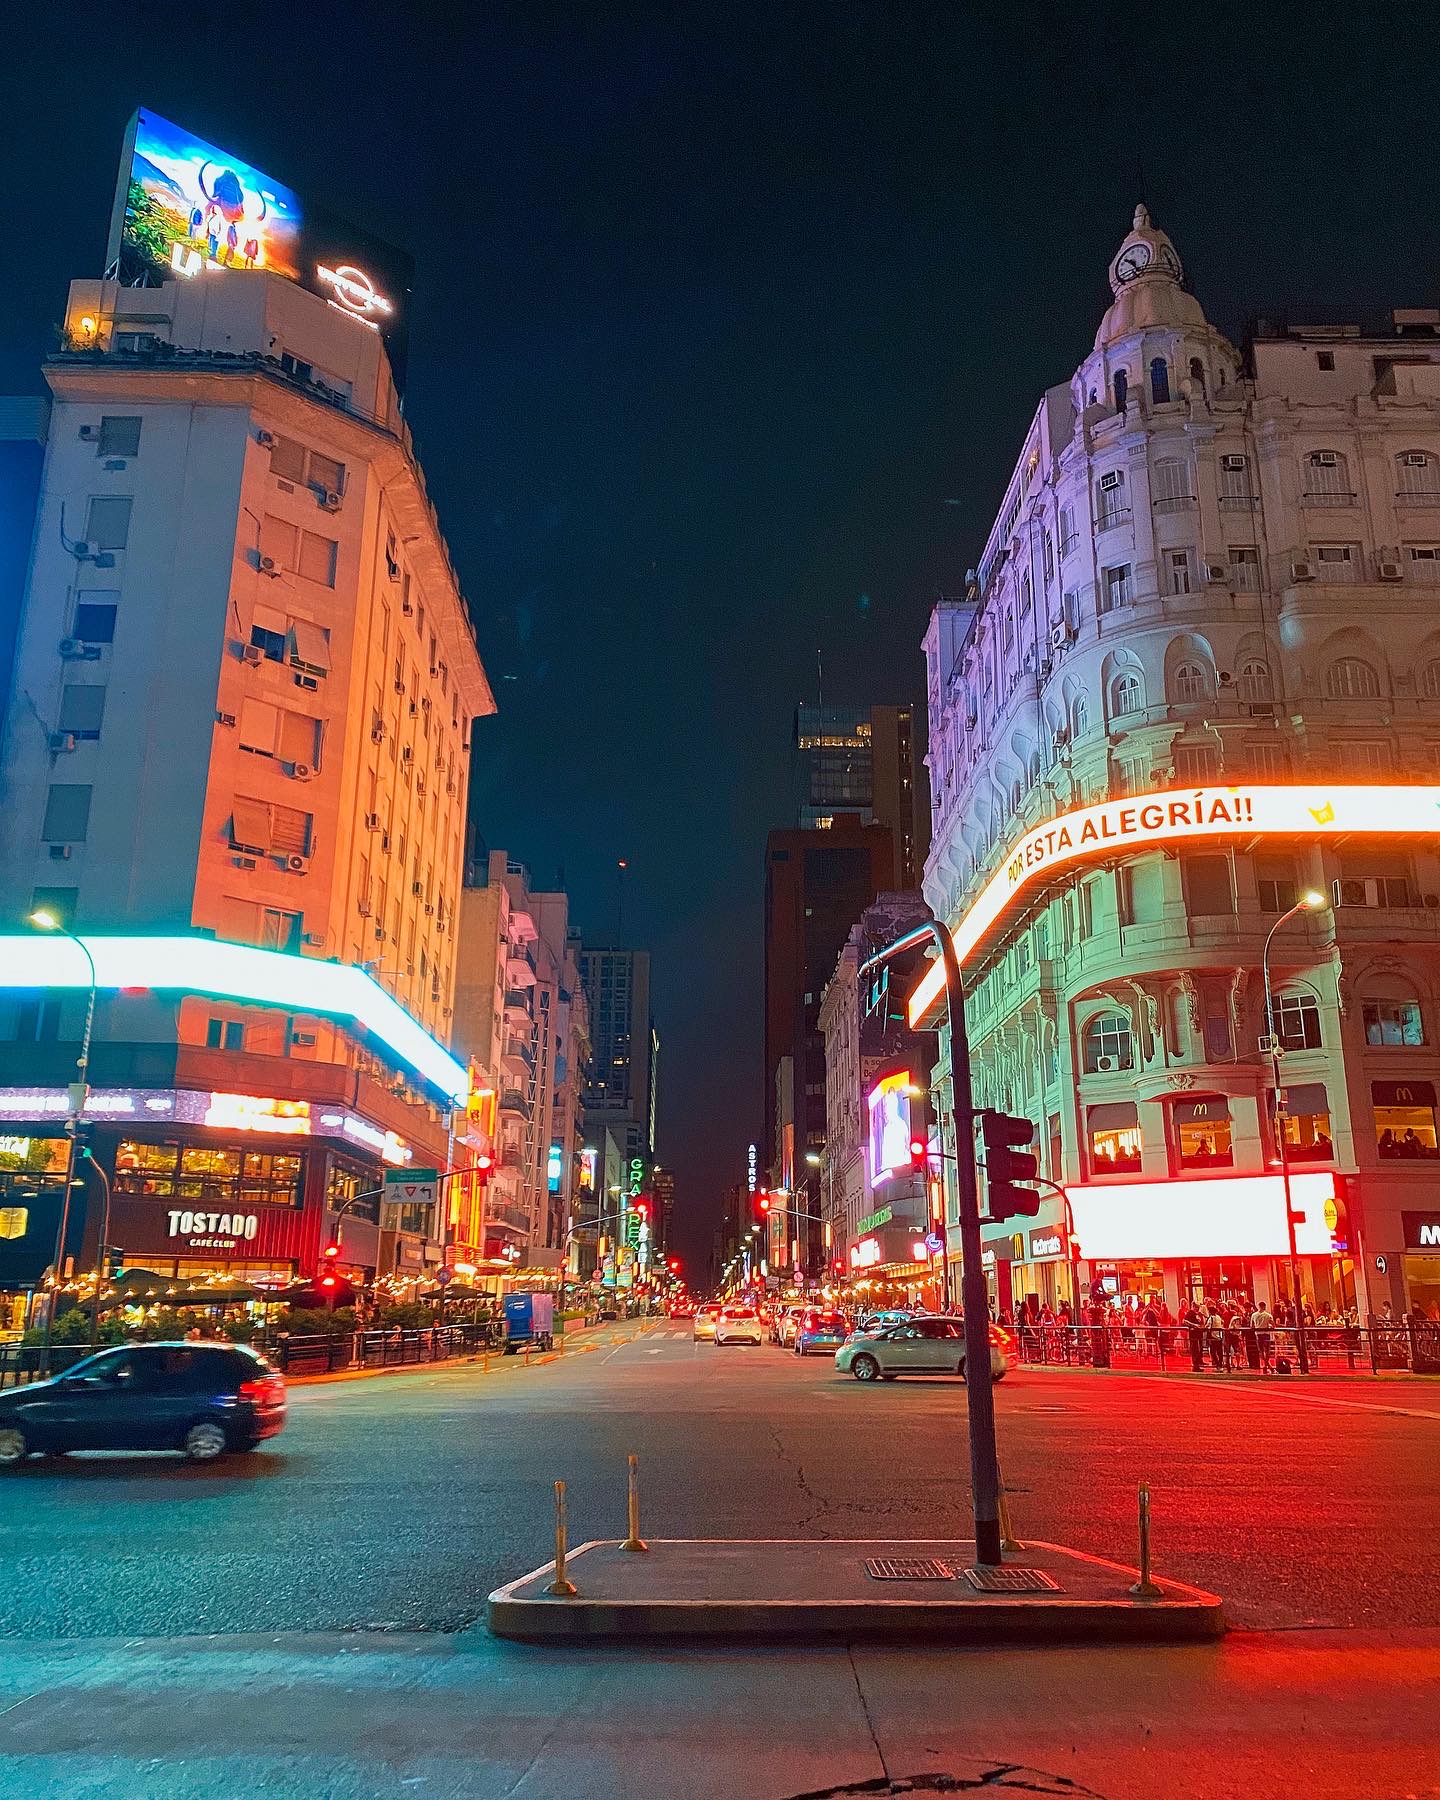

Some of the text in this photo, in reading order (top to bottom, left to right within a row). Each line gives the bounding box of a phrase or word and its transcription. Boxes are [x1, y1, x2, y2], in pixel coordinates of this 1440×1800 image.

[1007, 791, 1253, 886] POR ESTA ALEGRÍA!!
[630, 1158, 643, 1196] GRA
[748, 1144, 757, 1192] ASTROS
[167, 1210, 258, 1240] TOSTADO
[189, 1236, 236, 1248] CAFÉ CLUB
[628, 1212, 641, 1251] REX
